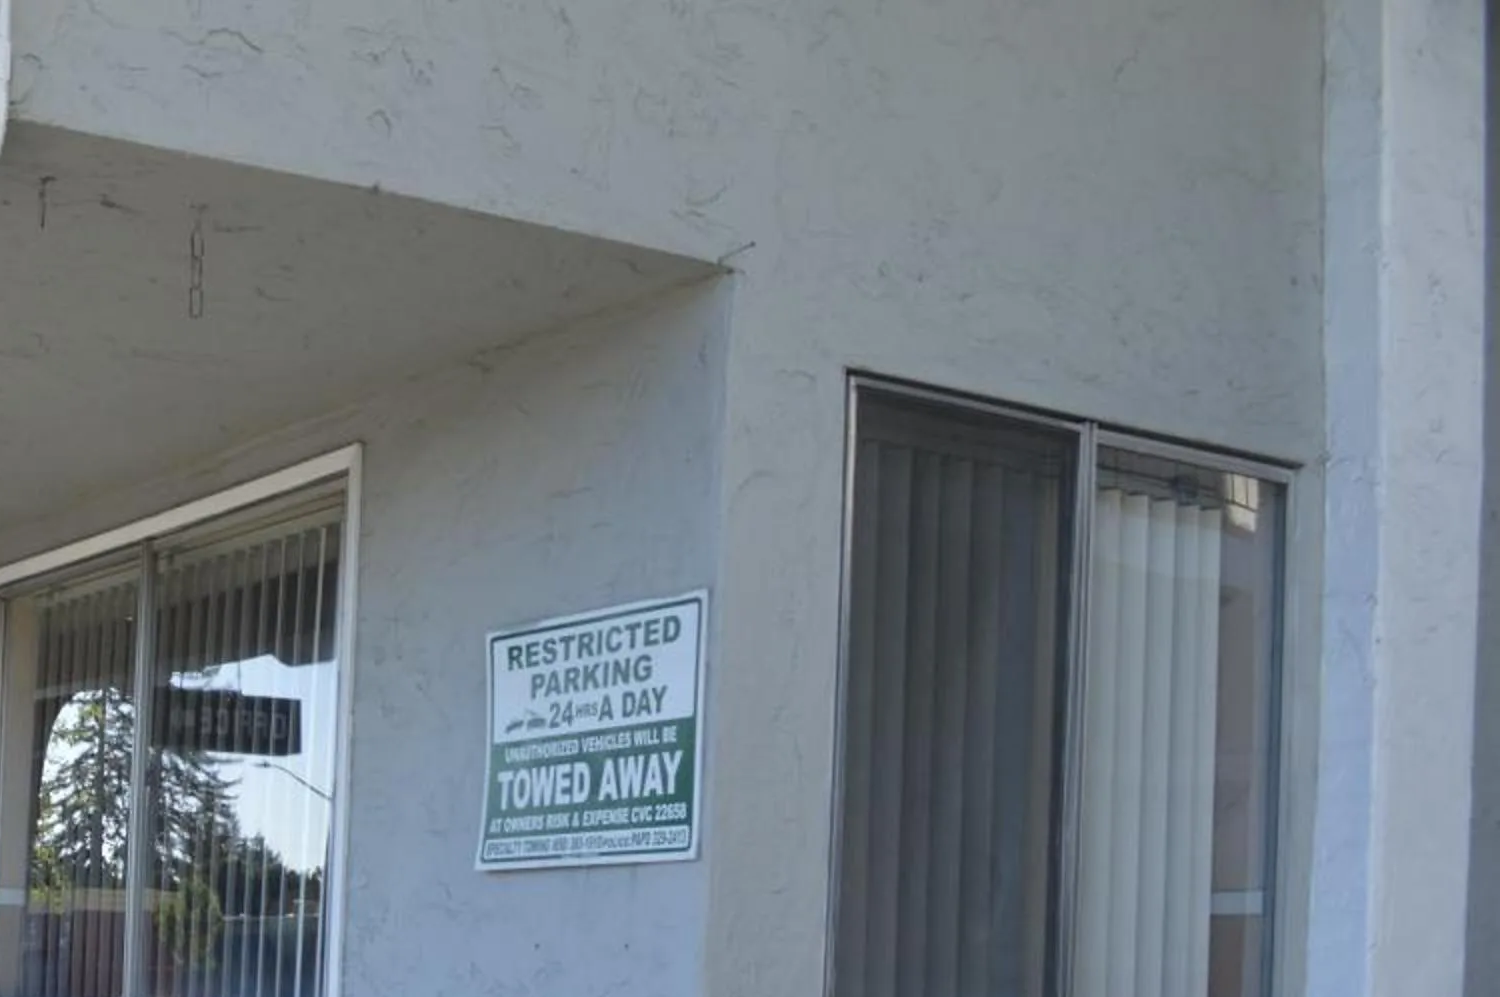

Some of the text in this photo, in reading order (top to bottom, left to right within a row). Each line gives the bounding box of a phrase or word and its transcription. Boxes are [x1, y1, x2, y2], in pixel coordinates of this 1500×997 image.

[507, 615, 681, 671] RESTRICTED
[531, 653, 653, 700] PARKING
[548, 700, 574, 729] 24
[597, 694, 614, 721] A
[622, 685, 668, 719] DAY
[582, 731, 632, 754] VEHICLES
[634, 728, 660, 746] WILL
[662, 725, 677, 743] BE
[497, 750, 684, 811] TOWED AWAY
[489, 818, 503, 834] AT
[546, 813, 570, 831] RISK
[582, 807, 629, 827] EXPENSE
